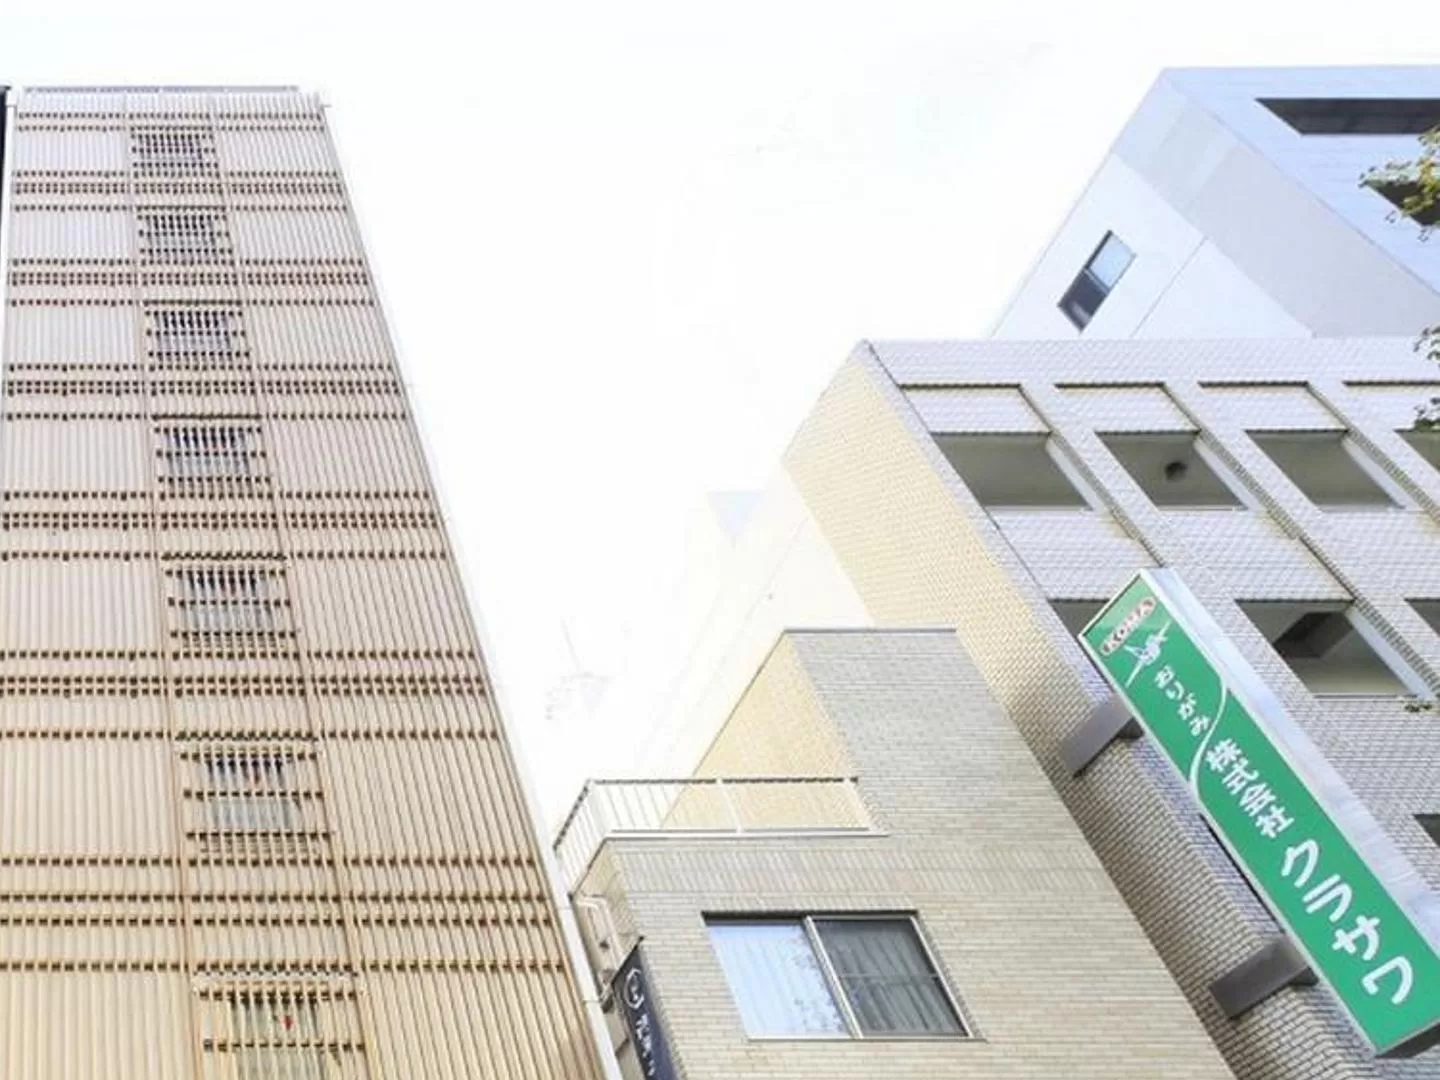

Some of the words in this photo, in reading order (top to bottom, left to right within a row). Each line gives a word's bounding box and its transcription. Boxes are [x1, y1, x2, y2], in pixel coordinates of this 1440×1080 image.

[1154, 665, 1211, 736] おりがみ
[1206, 738, 1295, 840] 株式会社
[1279, 838, 1415, 1006] クラサワ
